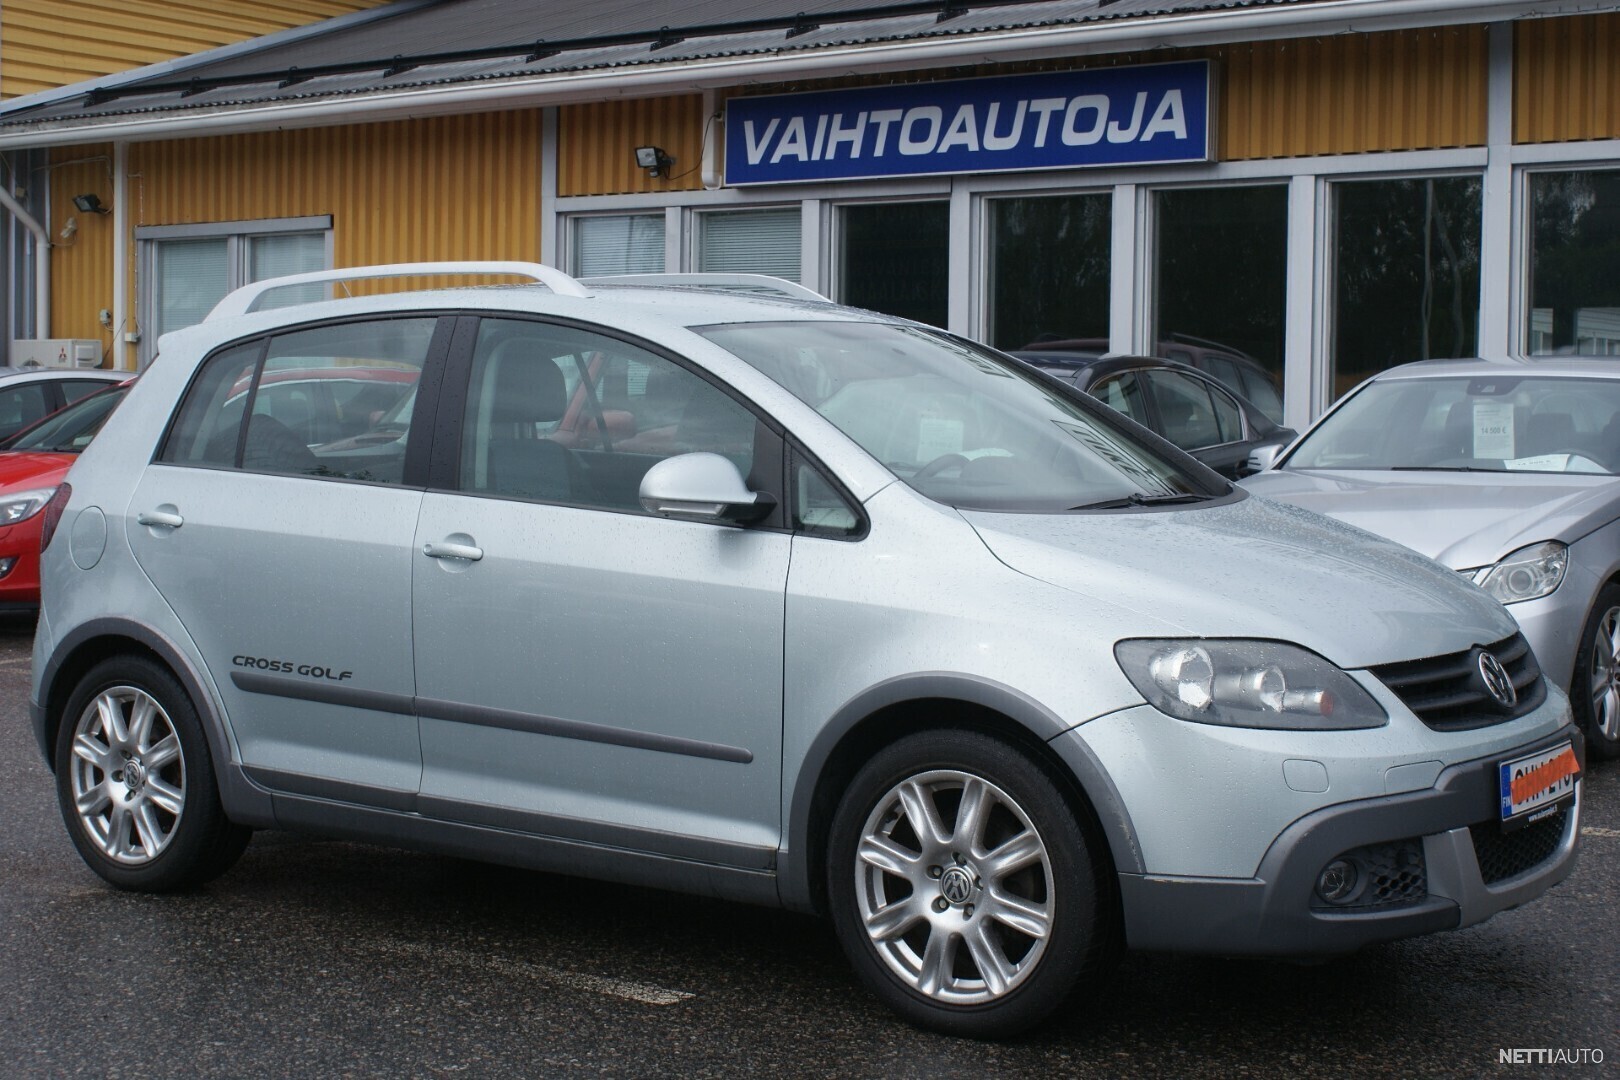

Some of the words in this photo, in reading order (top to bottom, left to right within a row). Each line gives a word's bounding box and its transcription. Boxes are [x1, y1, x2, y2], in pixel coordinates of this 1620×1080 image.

[743, 88, 1188, 166] VAIHTOAUTOJA
[231, 655, 294, 673] CROSS
[297, 664, 353, 681] GOLF
